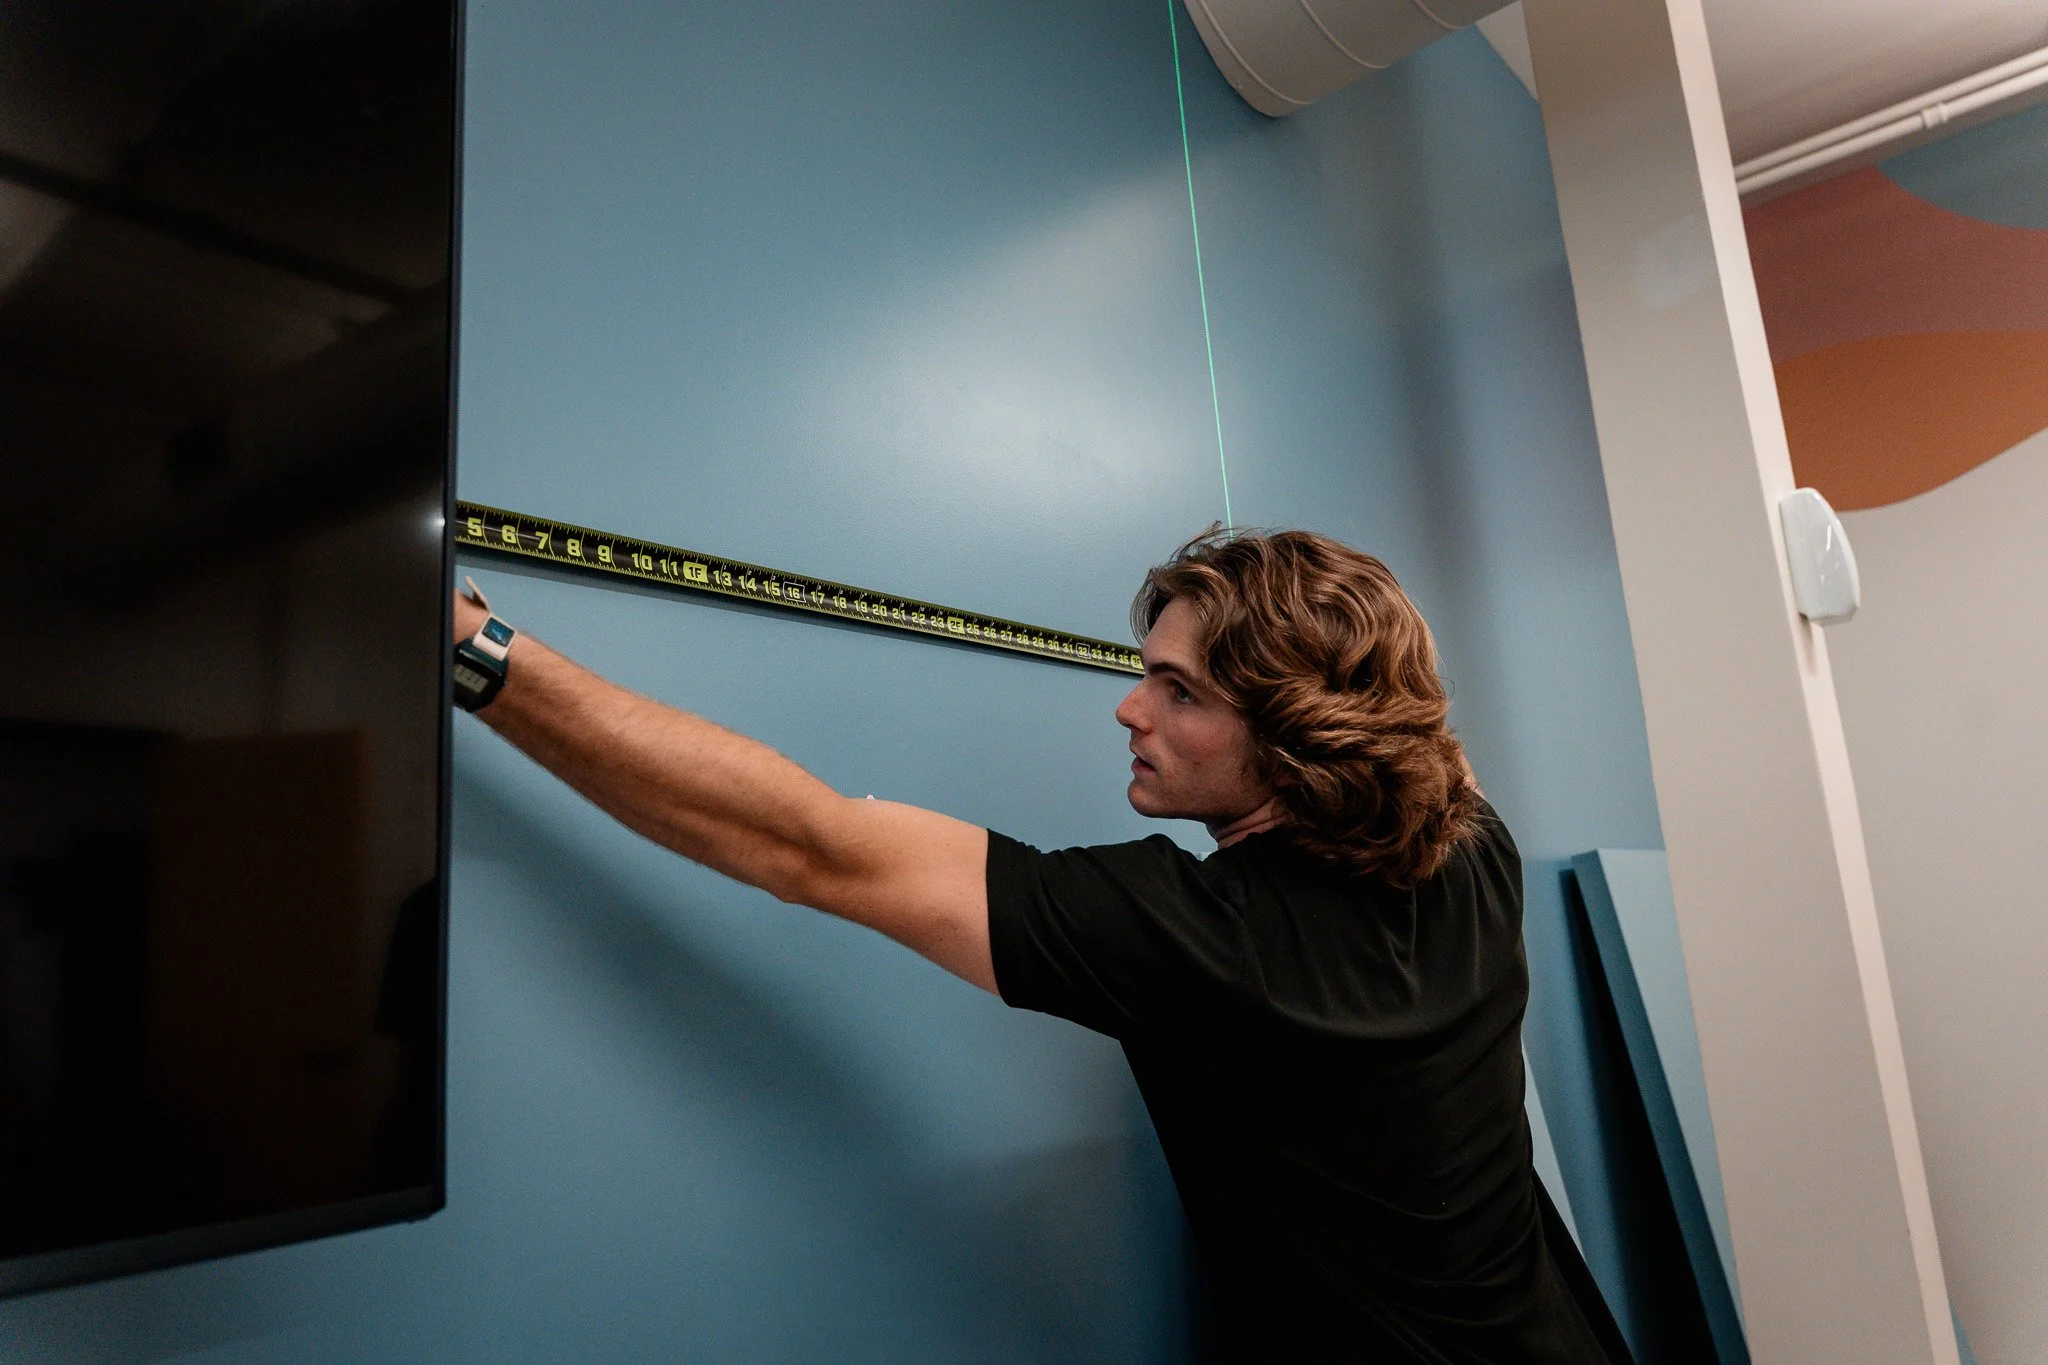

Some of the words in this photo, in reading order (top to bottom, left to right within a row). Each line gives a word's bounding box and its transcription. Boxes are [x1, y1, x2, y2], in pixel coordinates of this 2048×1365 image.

[467, 517, 483, 537] 5
[502, 525, 517, 543] 6
[535, 532, 549, 550] 7
[567, 538, 581, 557] 8
[598, 545, 611, 563] 9
[631, 552, 653, 571] 10
[660, 559, 679, 576] 11
[688, 566, 702, 579] 1F
[713, 570, 733, 587] 13
[738, 575, 757, 592] 14
[763, 580, 781, 596] 15
[787, 586, 800, 599] 16
[810, 591, 825, 604] 17
[832, 596, 847, 609] 18
[854, 600, 868, 613] 19
[872, 604, 888, 617] 20
[892, 608, 906, 621] 21
[911, 612, 926, 625] 22
[930, 616, 945, 628] 23
[966, 623, 980, 635] 25
[983, 626, 997, 639] 26
[1000, 630, 1013, 641] 27
[1047, 640, 1059, 651] 30
[1062, 643, 1074, 654] 31
[1077, 646, 1088, 656] 32
[1105, 651, 1116, 662] 34
[1118, 654, 1129, 665] 35
